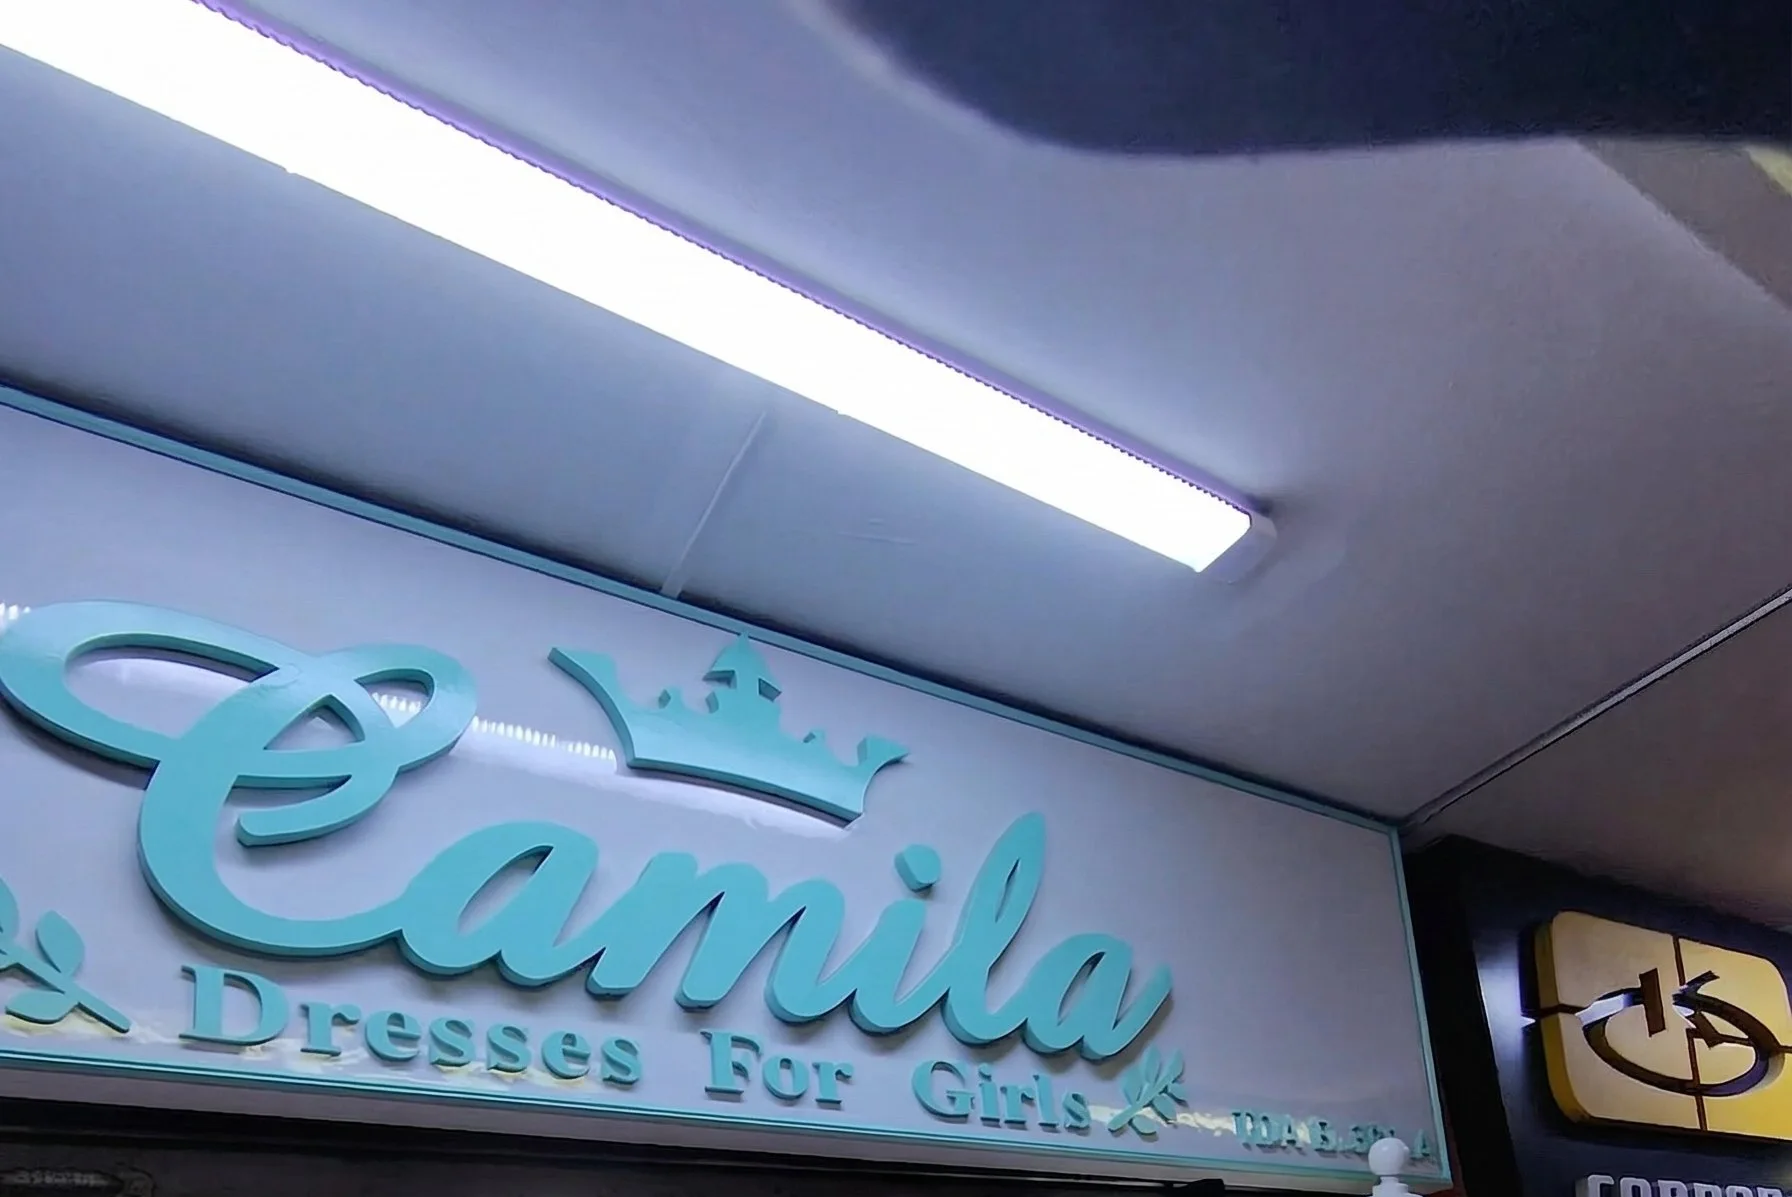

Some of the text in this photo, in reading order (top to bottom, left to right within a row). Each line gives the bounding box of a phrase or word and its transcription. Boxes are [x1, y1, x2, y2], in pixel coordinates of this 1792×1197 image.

[0, 599, 1173, 1062] Camila
[179, 963, 1091, 1132] Dresses For Girls
